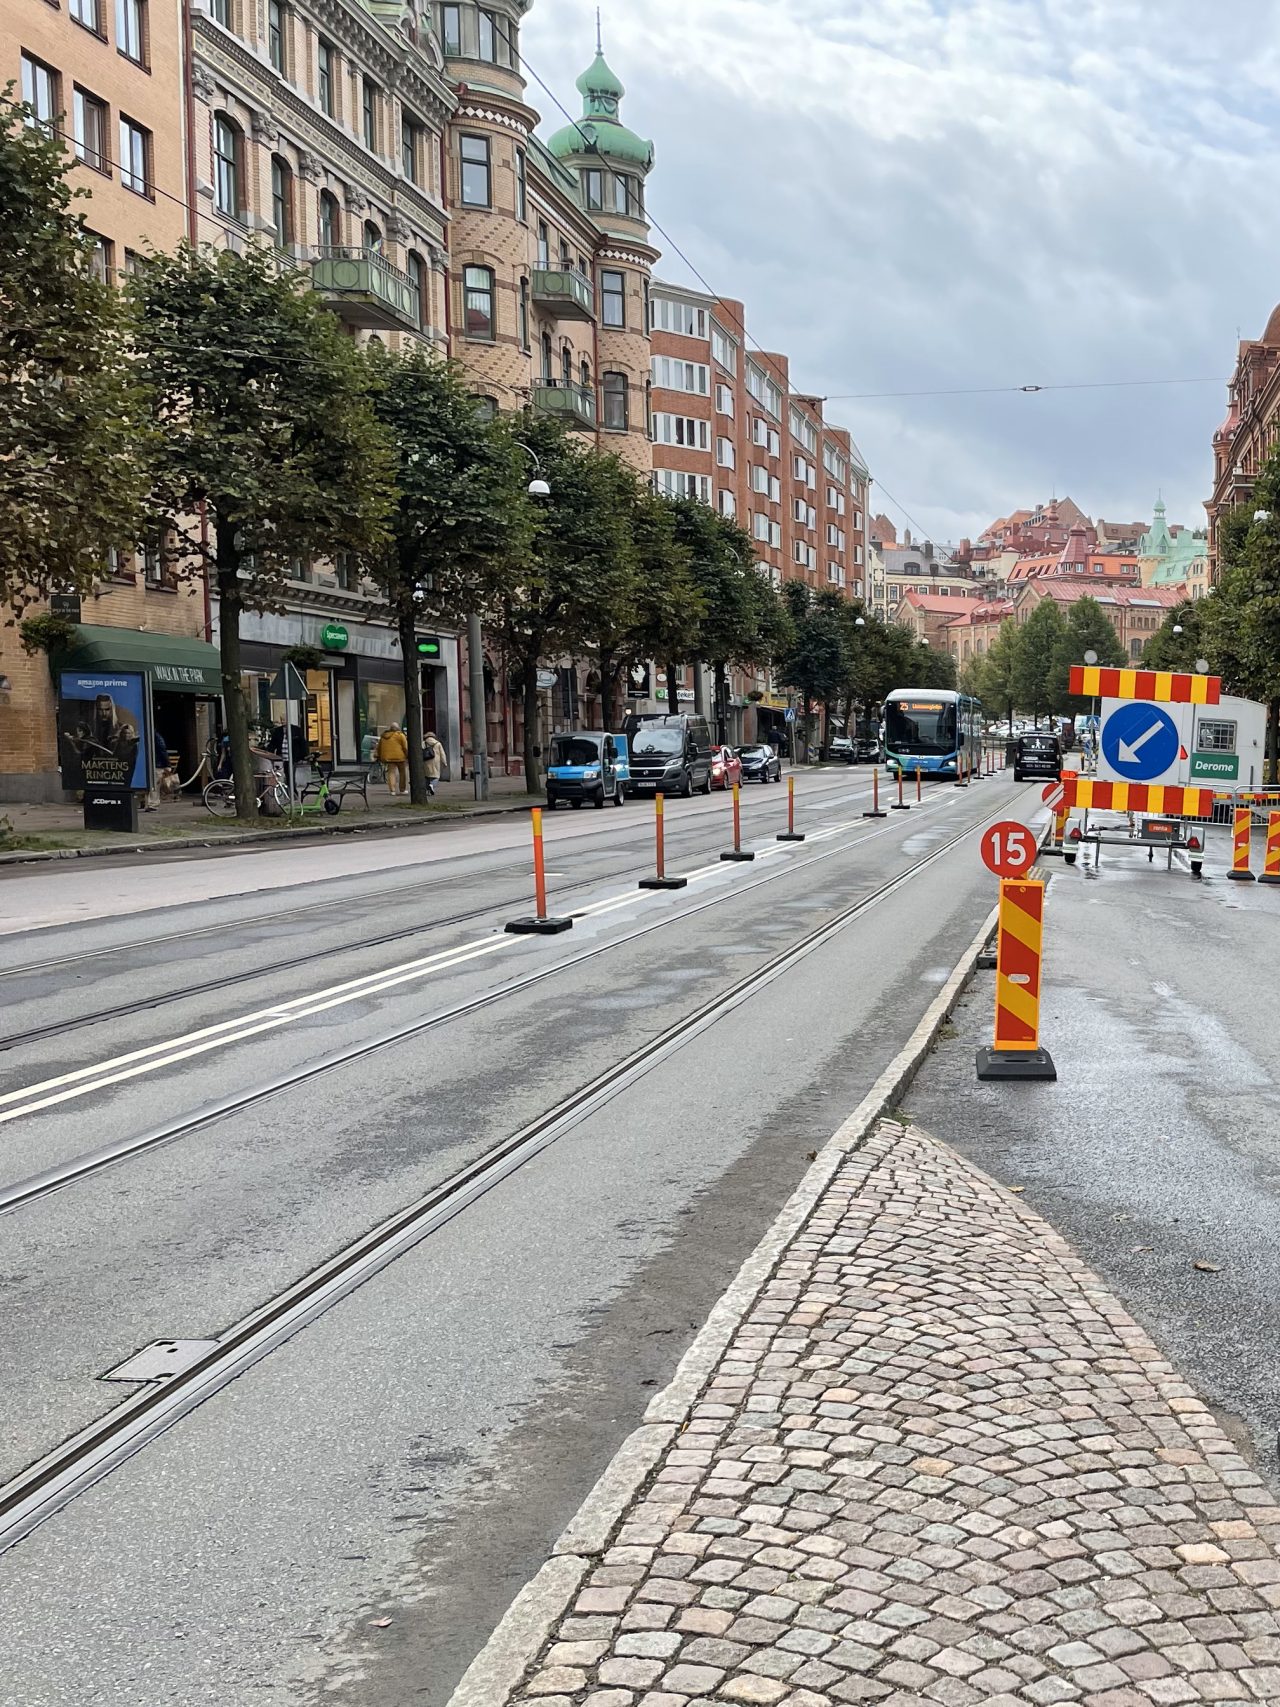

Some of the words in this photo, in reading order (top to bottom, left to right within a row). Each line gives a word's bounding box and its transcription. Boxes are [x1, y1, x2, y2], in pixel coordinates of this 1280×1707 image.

[104, 680, 128, 688] prime
[899, 702, 909, 711] 25
[81, 760, 129, 771] MAKTENS
[1195, 761, 1234, 772] Derome
[86, 769, 125, 781] RINGAR
[991, 832, 1027, 866] 15
